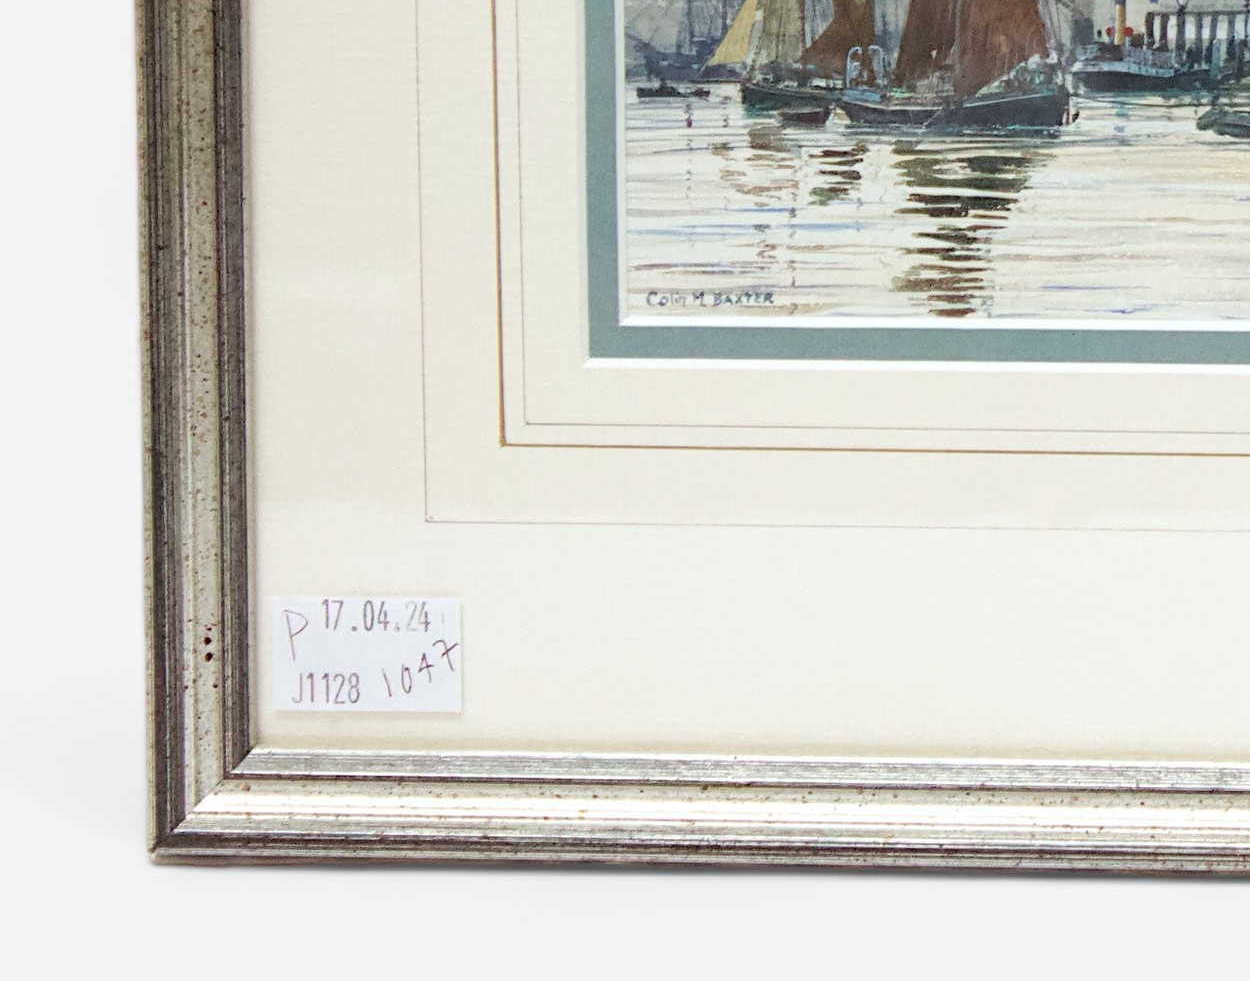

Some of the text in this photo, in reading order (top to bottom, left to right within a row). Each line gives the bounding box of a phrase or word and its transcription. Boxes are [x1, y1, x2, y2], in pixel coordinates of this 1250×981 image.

[712, 291, 774, 307] BAXTER
[321, 598, 431, 632] 17.04.24
[282, 609, 309, 661] P
[381, 639, 459, 699] 1047
[291, 672, 360, 704] J1128
